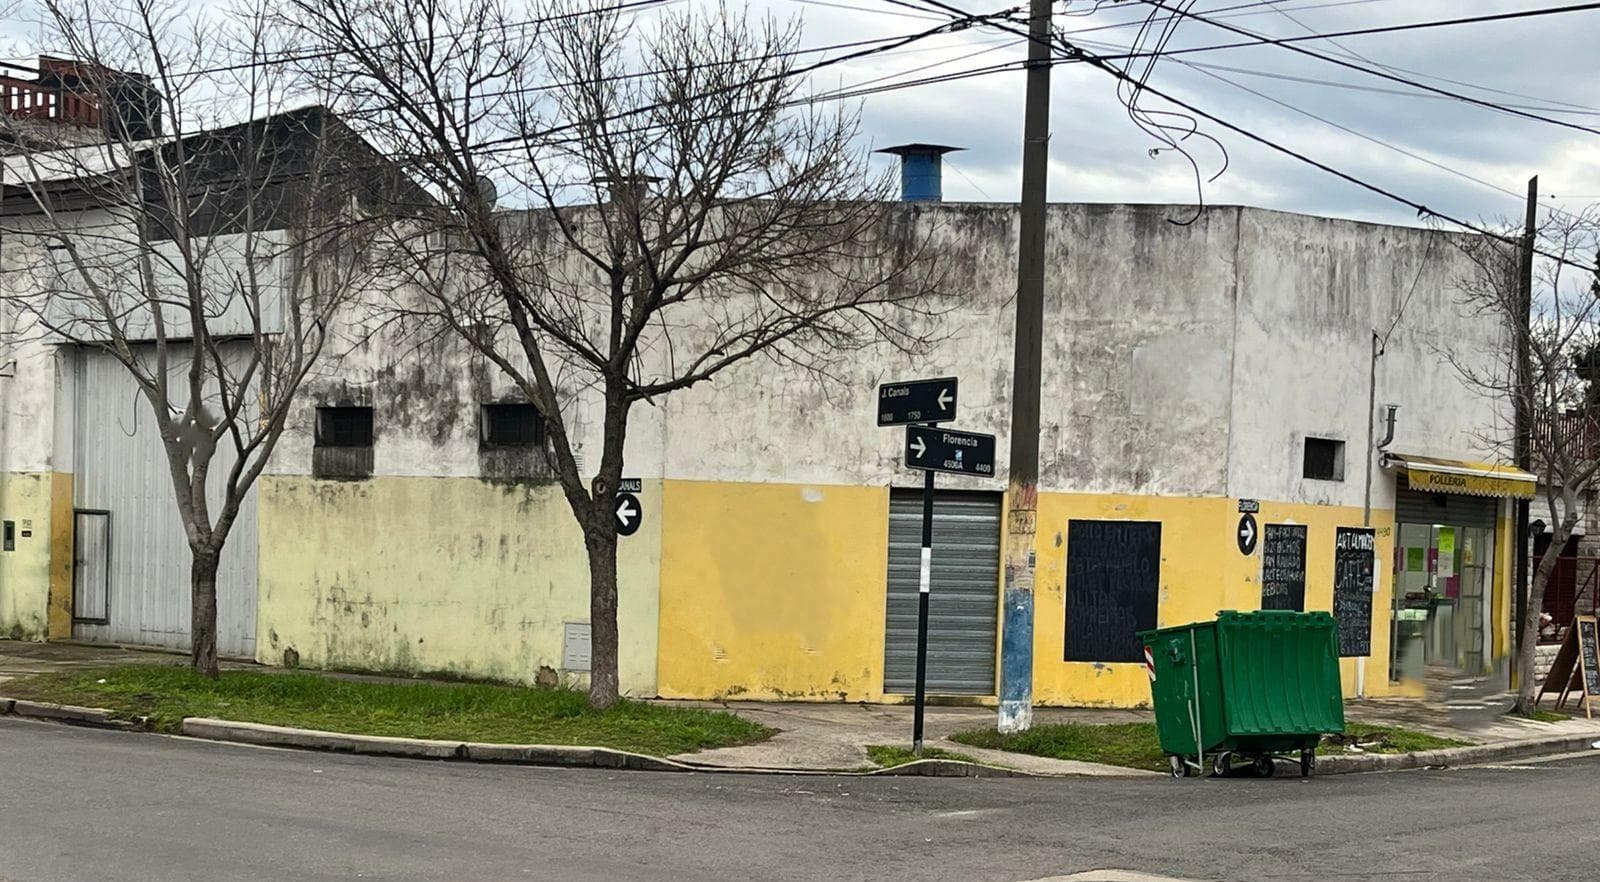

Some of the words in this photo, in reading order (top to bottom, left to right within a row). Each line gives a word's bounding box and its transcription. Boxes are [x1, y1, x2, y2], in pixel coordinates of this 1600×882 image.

[881, 389, 887, 399] J.
[888, 387, 910, 398] Canals
[943, 433, 978, 447] Florencia
[975, 463, 991, 473] 4400
[1429, 474, 1467, 487] POLLERIA
